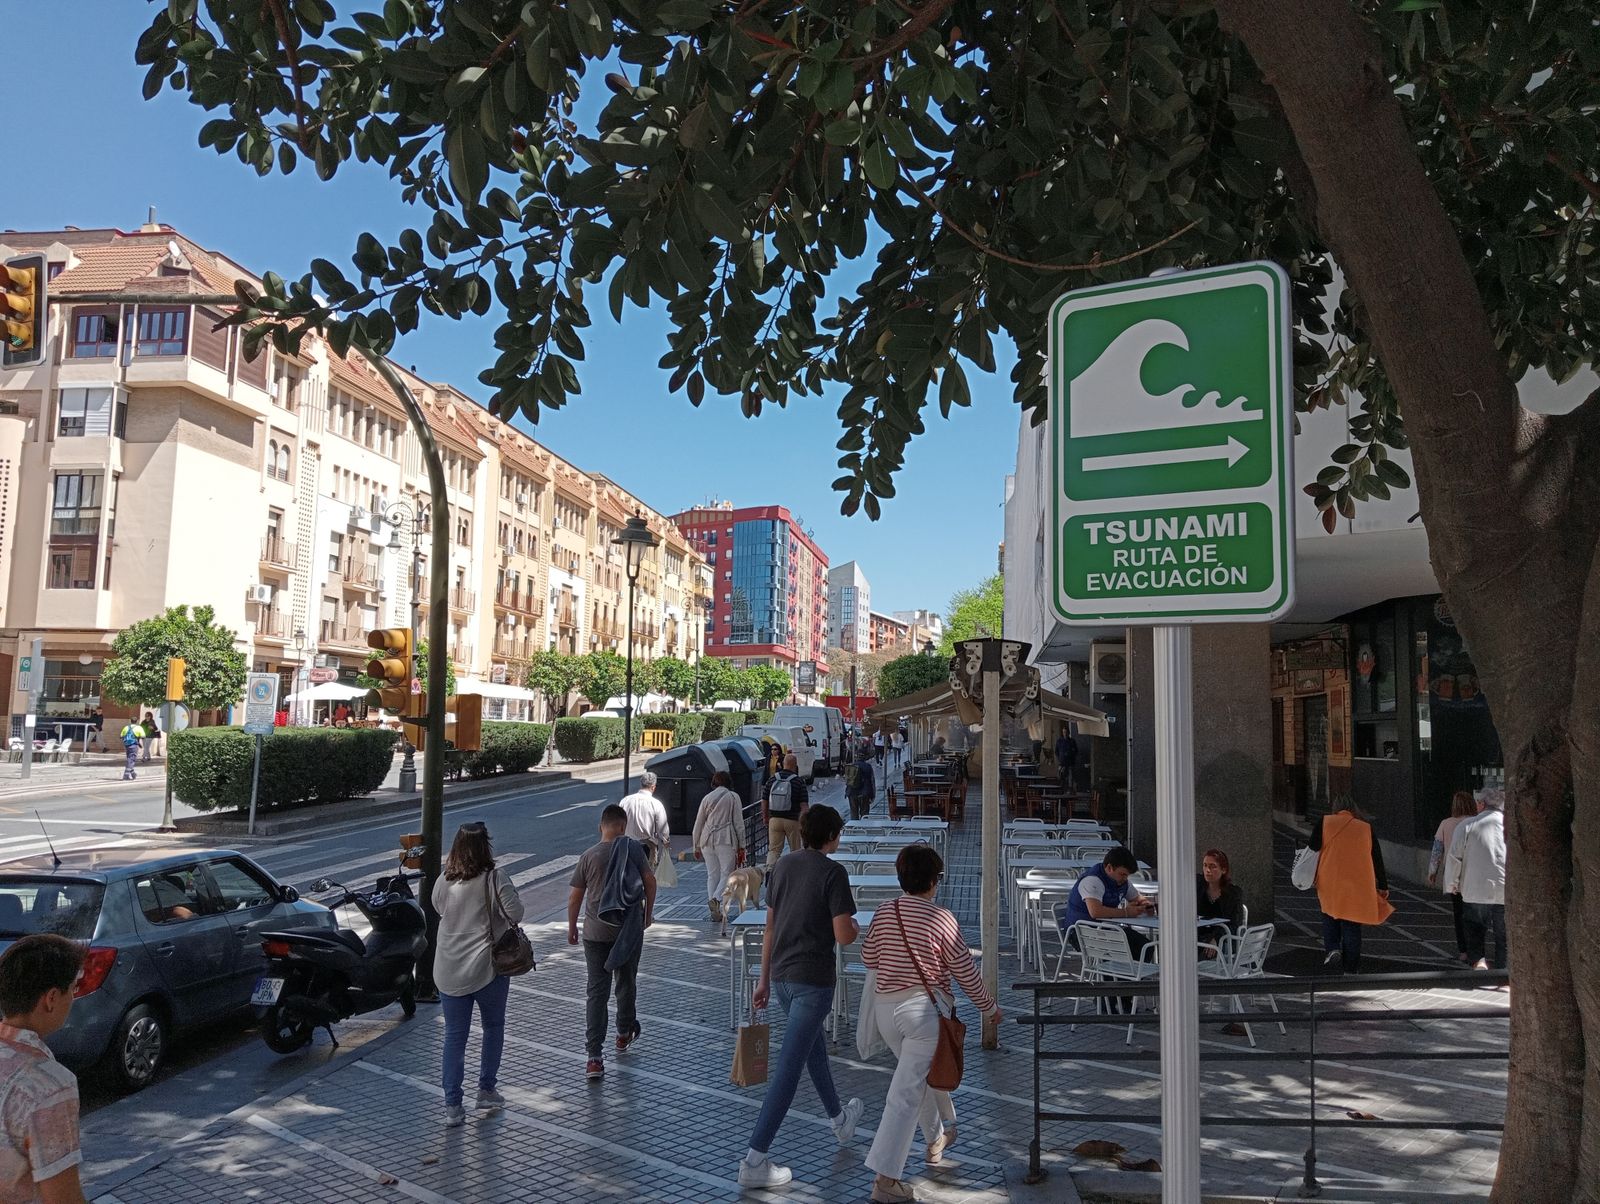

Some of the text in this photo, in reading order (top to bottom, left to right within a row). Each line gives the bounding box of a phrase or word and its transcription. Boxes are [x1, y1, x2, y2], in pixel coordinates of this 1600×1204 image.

[1083, 512, 1248, 545] TSUNAMI
[1113, 544, 1218, 567] RUTA DE
[1087, 562, 1248, 592] EVACUACIÓN
